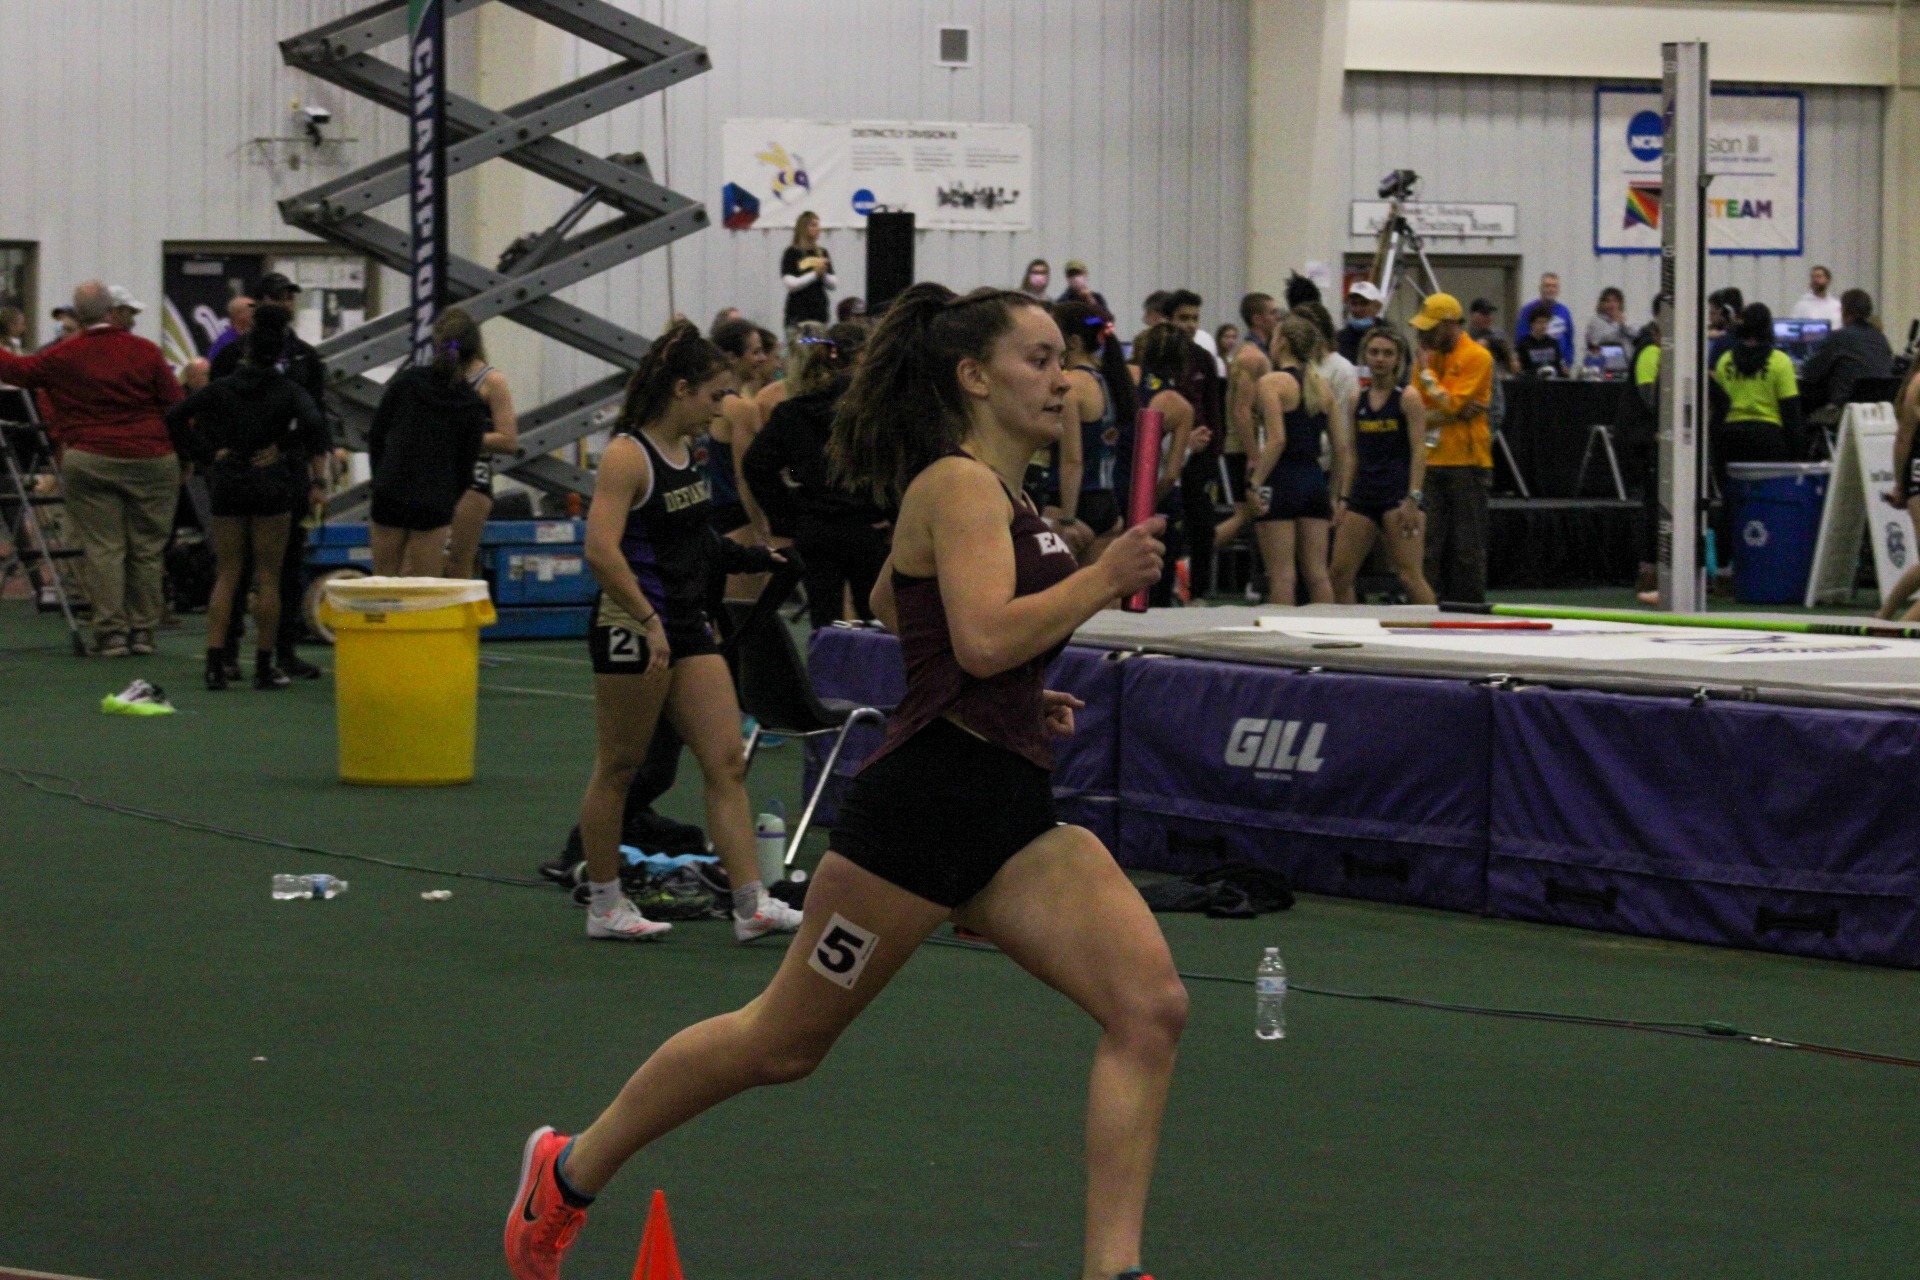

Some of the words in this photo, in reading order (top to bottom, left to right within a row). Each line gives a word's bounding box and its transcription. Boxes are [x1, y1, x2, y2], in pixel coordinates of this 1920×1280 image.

[1709, 136, 1742, 153] sion
[414, 37, 434, 366] CHAMPIONS
[1709, 198, 1773, 219] TEAM
[1033, 531, 1071, 555] EA
[612, 627, 634, 655] 2
[1225, 717, 1328, 772] GILL
[817, 925, 865, 974] 5
